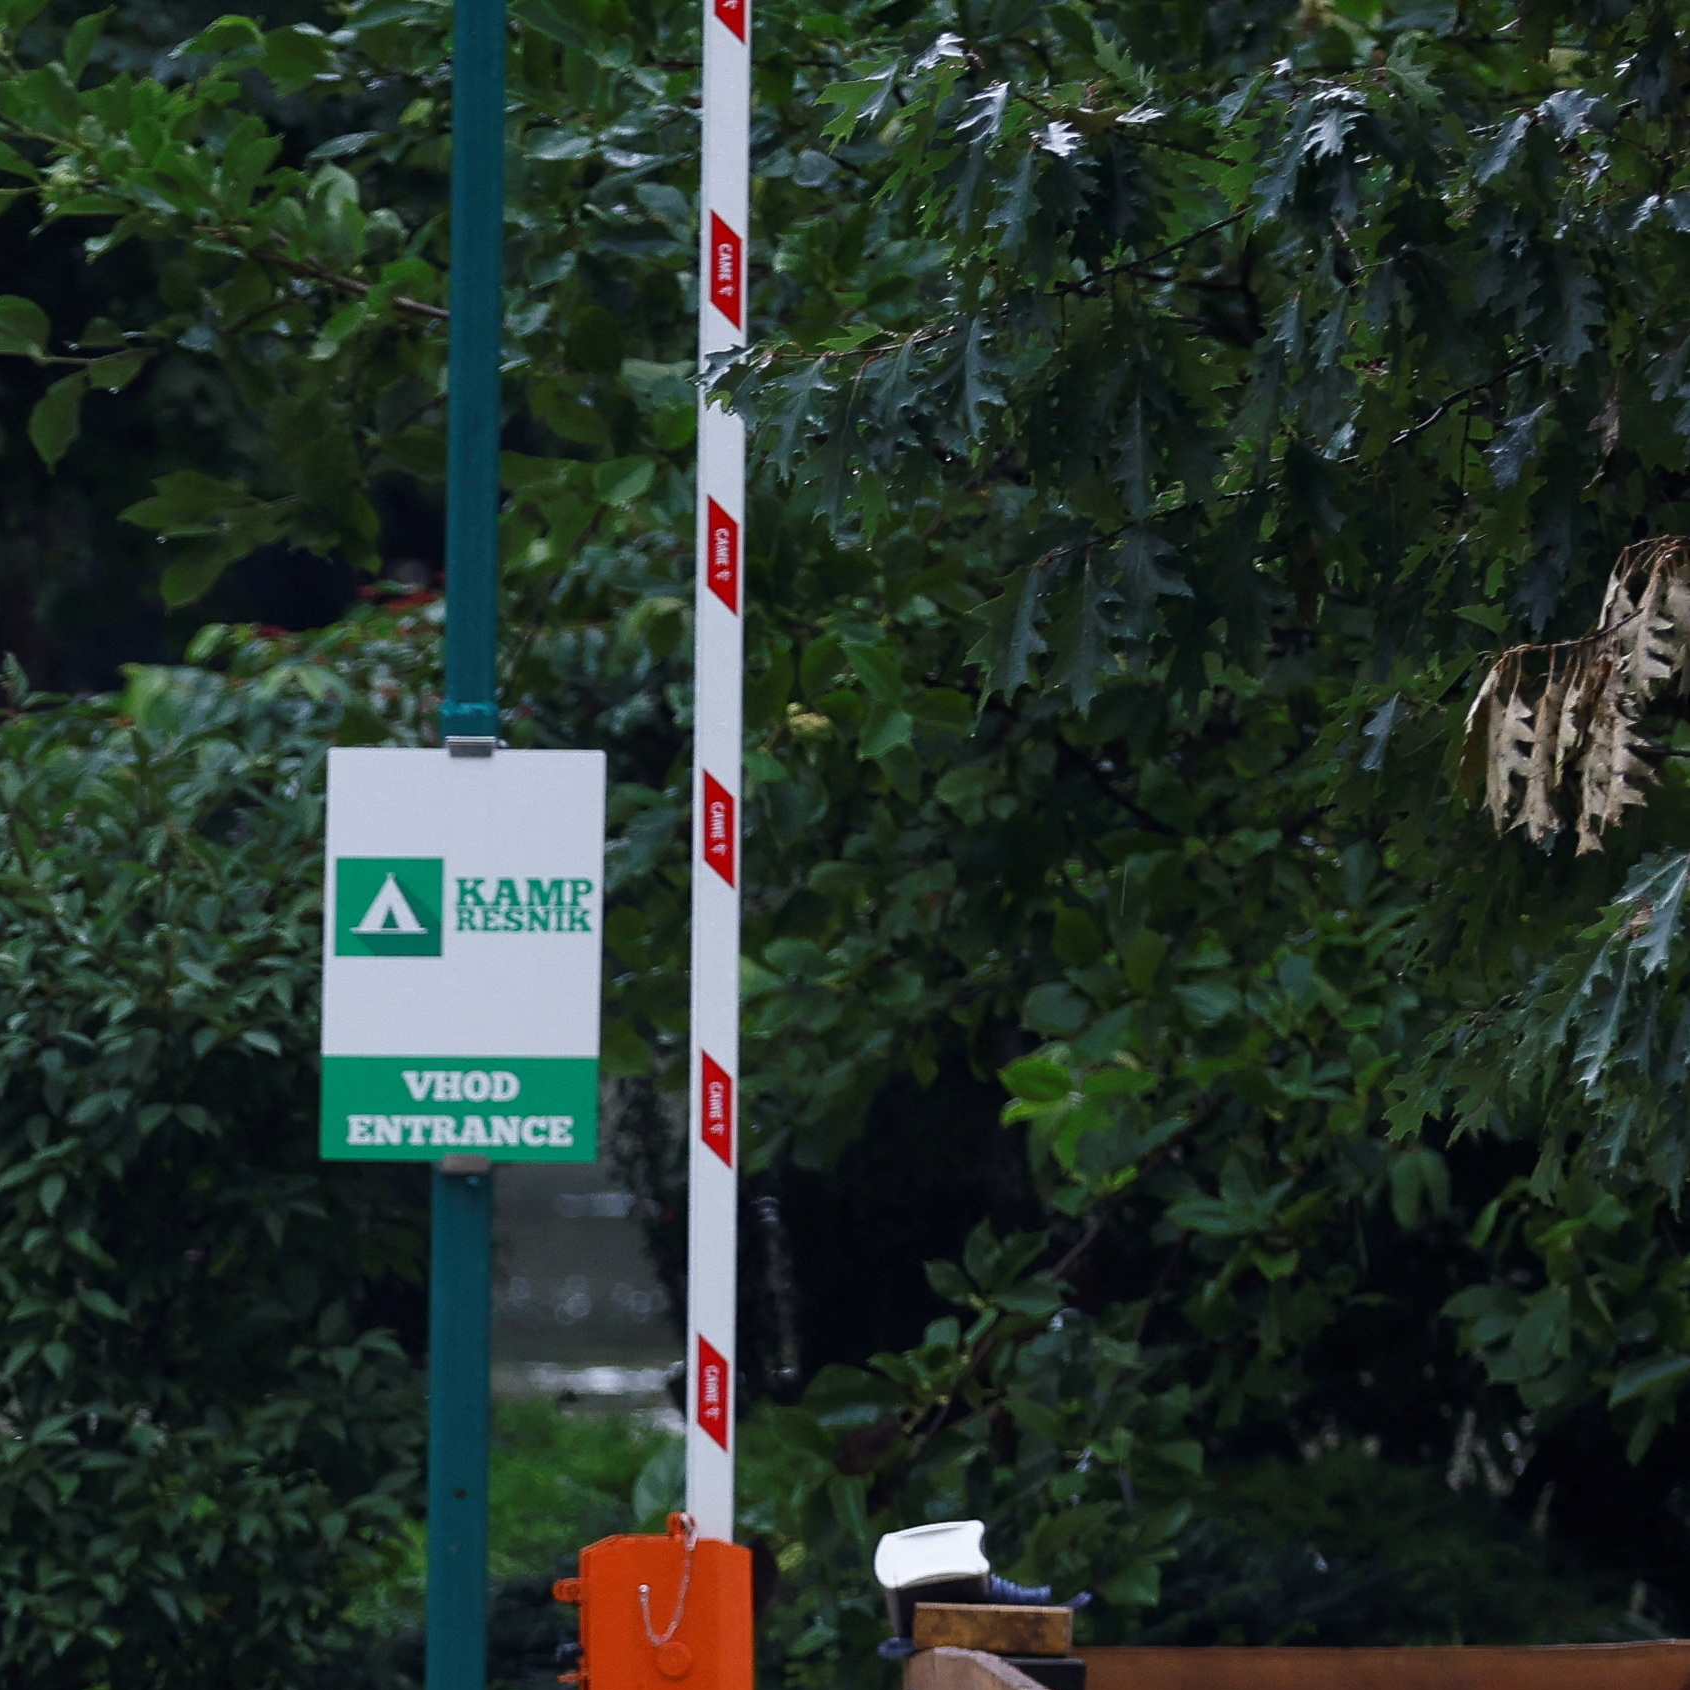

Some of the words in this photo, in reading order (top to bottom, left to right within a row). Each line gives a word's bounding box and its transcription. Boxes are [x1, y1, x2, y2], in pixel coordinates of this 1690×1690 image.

[717, 242, 734, 281] CAME
[455, 877, 594, 907] KAMP
[455, 907, 593, 933] RESNIK
[401, 1070, 521, 1102] VHOD
[346, 1115, 575, 1148] ENTRANCE
